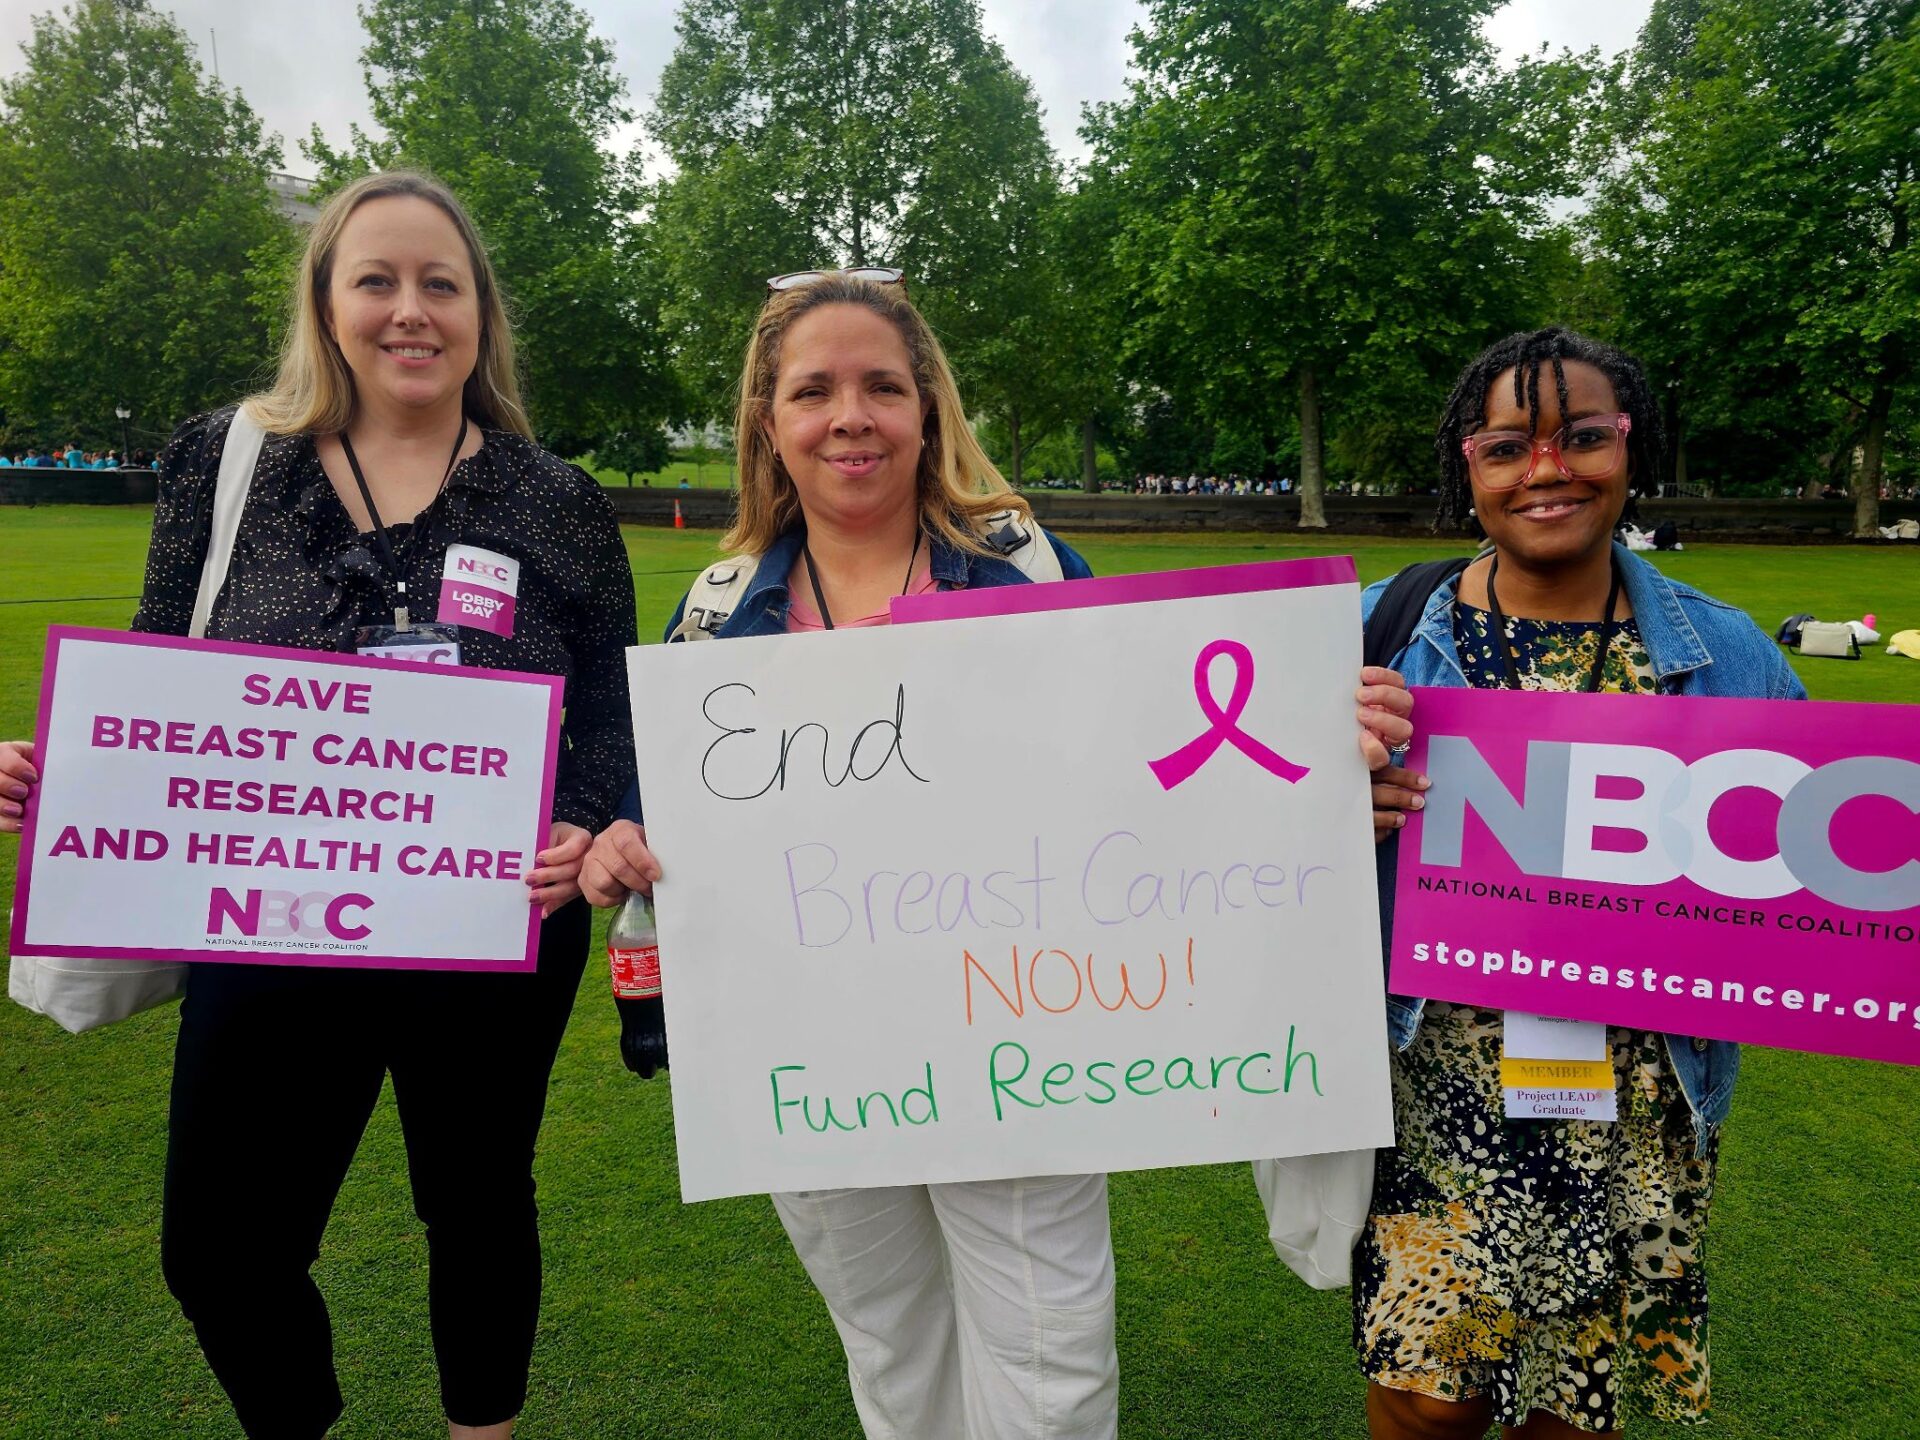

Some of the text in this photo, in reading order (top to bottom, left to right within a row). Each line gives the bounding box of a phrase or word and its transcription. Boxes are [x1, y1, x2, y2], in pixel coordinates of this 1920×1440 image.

[452, 590, 505, 611] LOBBY
[461, 603, 494, 619] DAY
[242, 673, 372, 714] SAVE
[91, 715, 508, 777] BREAST CANCER
[701, 682, 930, 801] End
[167, 777, 433, 823] RESEARCH
[1419, 734, 1920, 912] NBCC
[49, 825, 523, 880] AND HEALTH CARE
[206, 887, 375, 941] NBCC
[785, 831, 1335, 948] Breast Cancer
[1418, 876, 1920, 944] NATIONAL BREAST CANCER COALITIO
[205, 938, 249, 946] NATIONAL
[323, 943, 369, 951] COALITION
[963, 938, 1195, 1026] NOW!
[1412, 941, 1920, 1030] stopbreastcancer.or
[770, 1024, 1324, 1135] Fund Research
[1517, 1090, 1556, 1104] Project
[1520, 1066, 1593, 1078] MEMBER
[1532, 1104, 1586, 1116] Graduate
